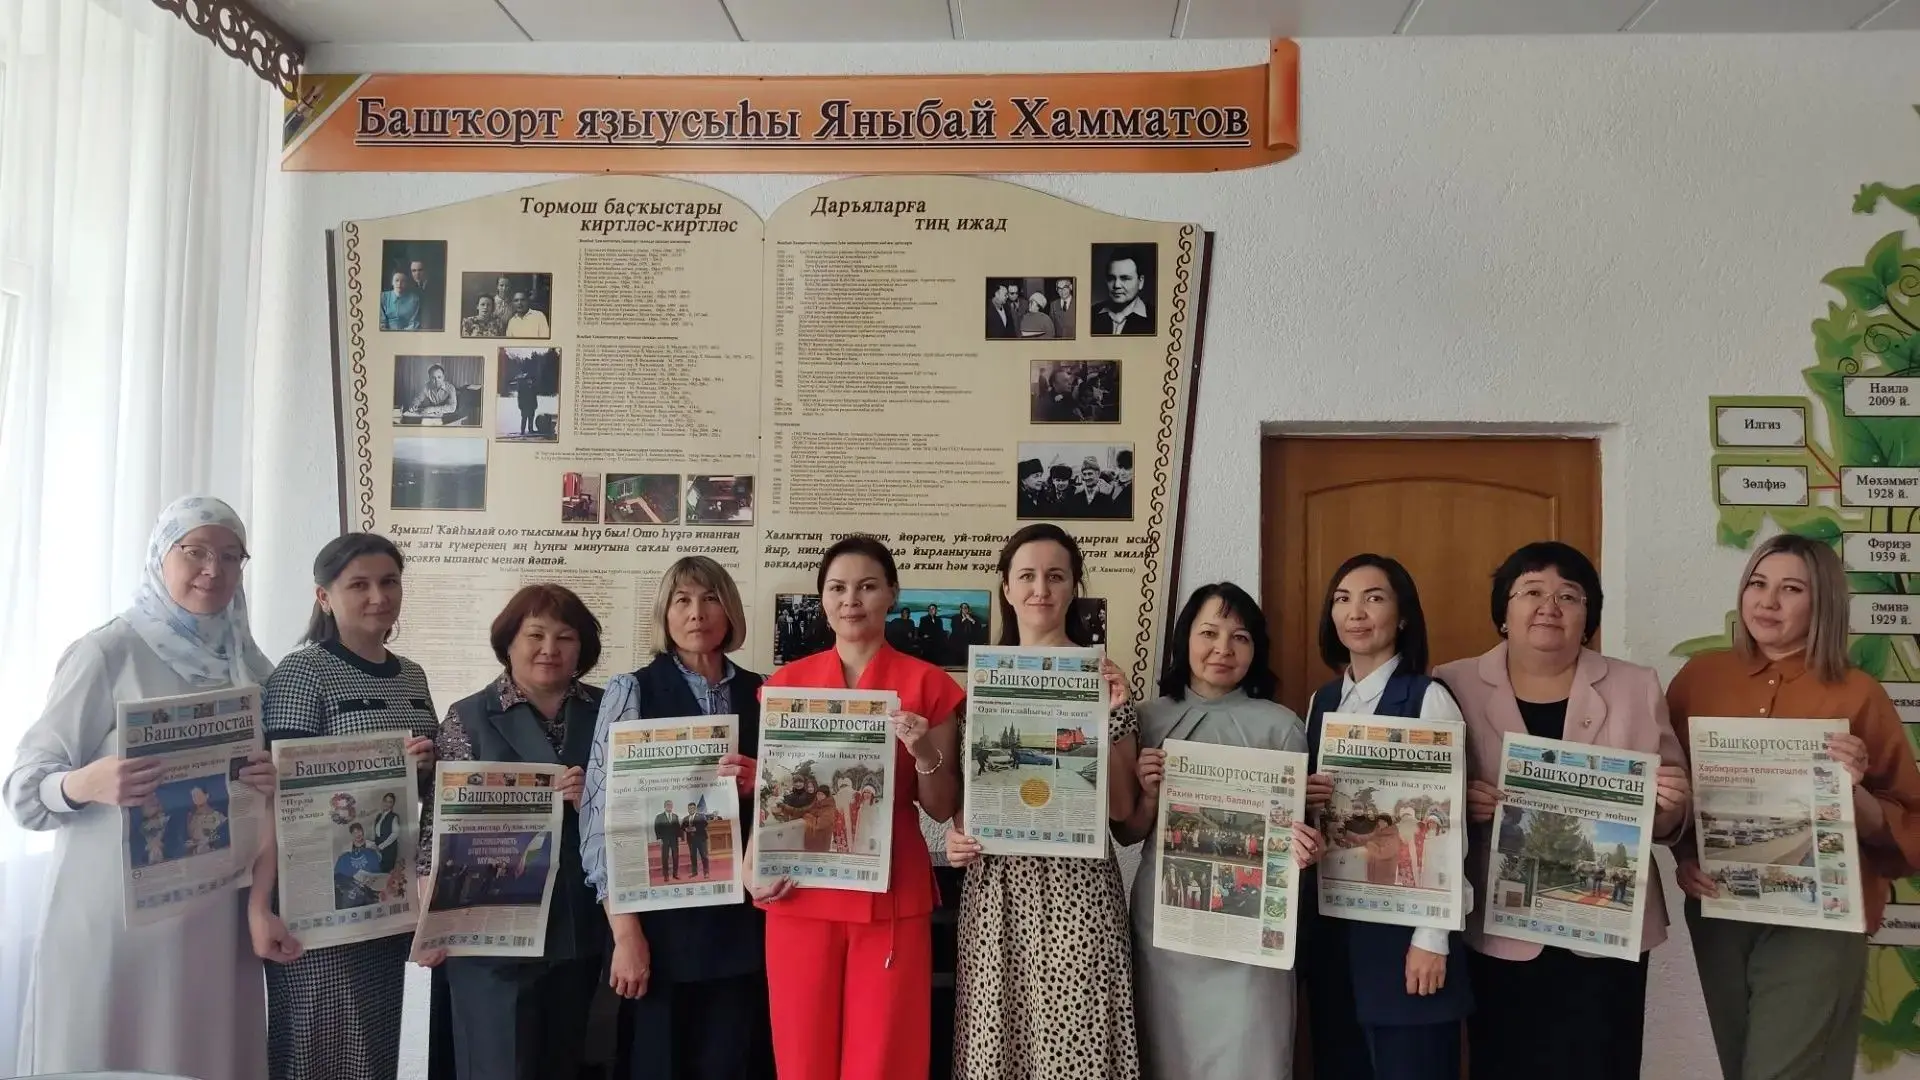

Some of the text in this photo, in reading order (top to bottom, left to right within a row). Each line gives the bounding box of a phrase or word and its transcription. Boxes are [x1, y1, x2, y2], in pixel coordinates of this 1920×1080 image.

[357, 97, 1250, 146] Башҡорт яҙыусыһы Яныбай Хамматов
[520, 196, 723, 219] Тормош баҫҡыстары
[811, 196, 926, 216] Даръяларға
[579, 217, 738, 237] киртләс-киртләс
[915, 216, 1008, 233] тиң ижад
[1870, 383, 1908, 393] Наилә
[1869, 396, 1910, 406] 2009 й.
[1744, 419, 1781, 430] Илгиз
[1742, 478, 1786, 492] Зөлфиә
[1856, 475, 1918, 487] Мөхәммәт
[1868, 489, 1908, 499] 1928 й.
[389, 524, 433, 537] Яҙмыш!
[498, 528, 518, 536] оло
[521, 528, 578, 537] тылсымлы
[605, 527, 630, 538] был!
[633, 527, 659, 538] Ошо
[695, 530, 740, 540] инанған
[766, 530, 822, 542] Халыҡтың
[513, 542, 527, 551] иң
[574, 543, 629, 553] минутына
[1868, 537, 1911, 551] Фәриҙә
[491, 556, 525, 565] менән
[528, 556, 567, 565] йәшәй.
[764, 545, 790, 557] йыр,
[913, 547, 992, 560] йырланыуына
[1870, 552, 1910, 562] 1939 й.
[914, 562, 943, 570] яҡын
[946, 561, 968, 570] һәм
[1872, 602, 1908, 612] Әминә
[1870, 614, 1896, 624] 1929
[990, 669, 1099, 690] Башҡортостан
[144, 715, 253, 743] Башҡортостан
[780, 712, 885, 732] Башҡортостан
[1337, 738, 1452, 762] Башҡортостан
[1708, 731, 1819, 754] Башҡортостан
[627, 743, 729, 759] Башҡортостан
[295, 755, 405, 777] Башҡортостан
[1179, 755, 1279, 784] Башҡортостан
[1523, 760, 1644, 793] Башҡортостан
[458, 786, 553, 805] Башҡортостан
